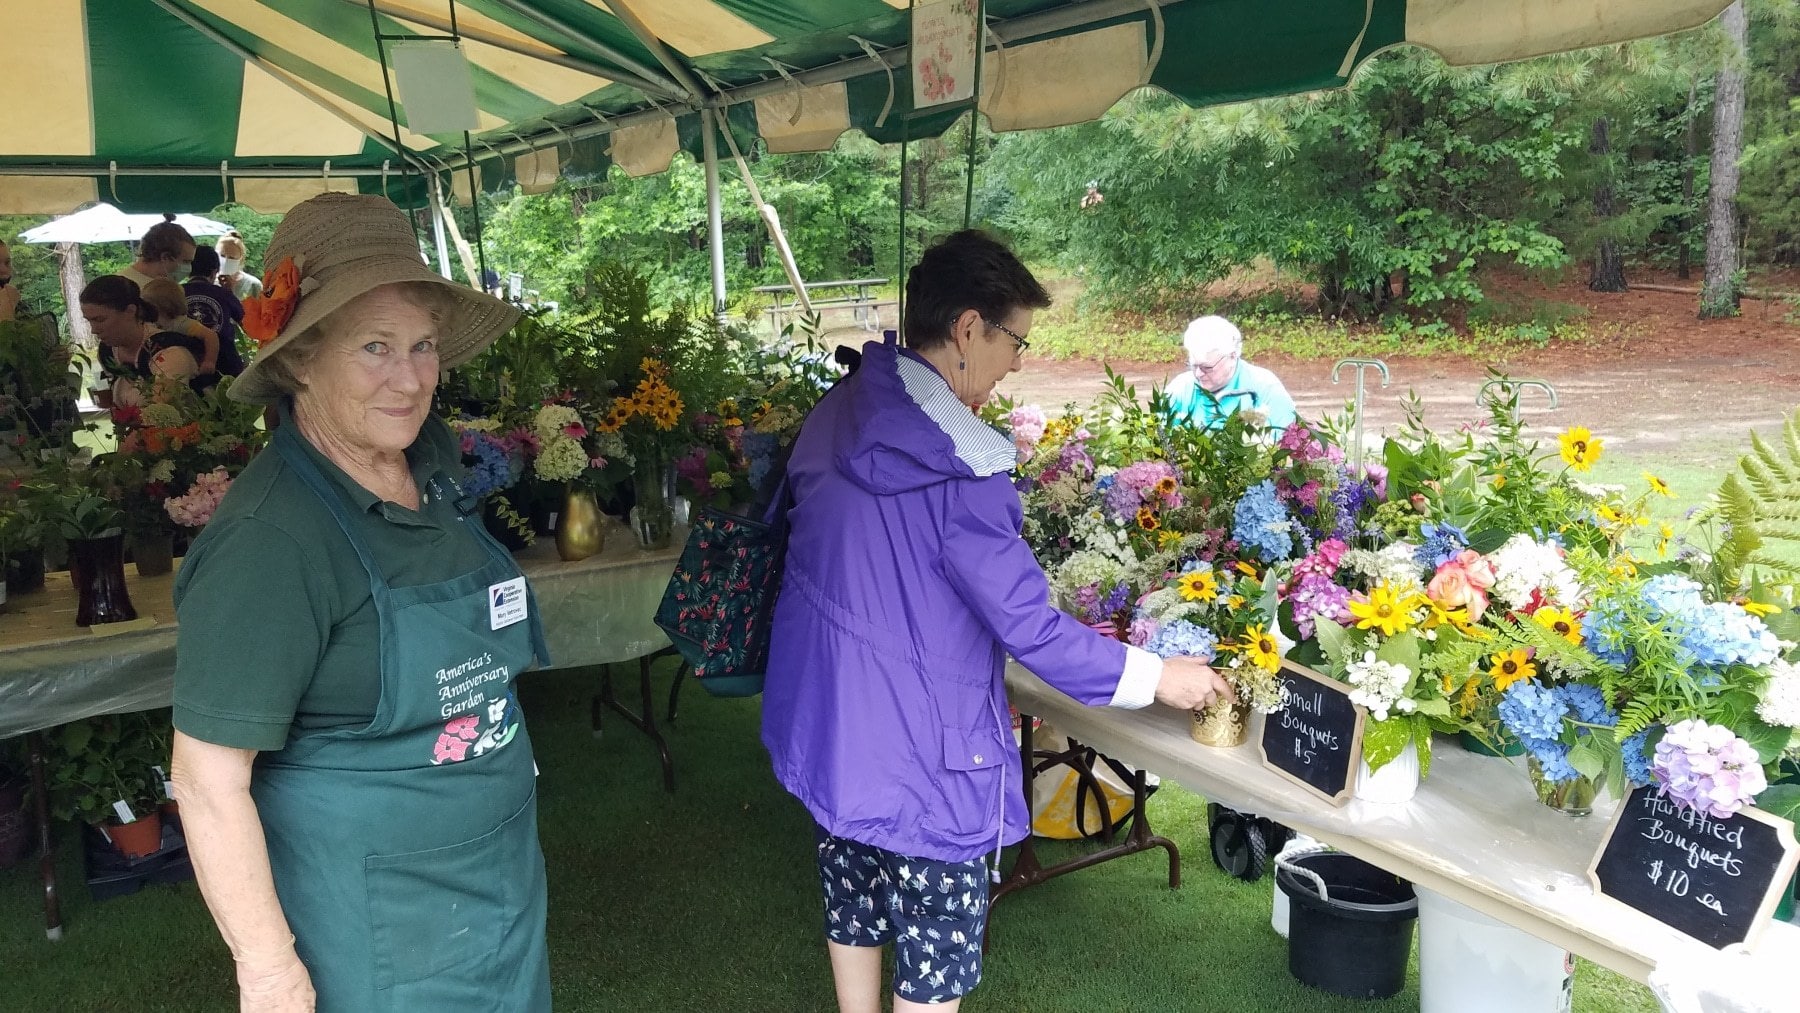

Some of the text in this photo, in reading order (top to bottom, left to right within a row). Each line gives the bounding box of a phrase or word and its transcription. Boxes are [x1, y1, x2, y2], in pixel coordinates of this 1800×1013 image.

[503, 596, 520, 605] Extension
[435, 652, 492, 685] America's
[438, 665, 509, 701] Anniversary
[441, 690, 485, 720] Garden
[1282, 680, 1322, 716] Small
[1638, 817, 1744, 877] Bouquets
